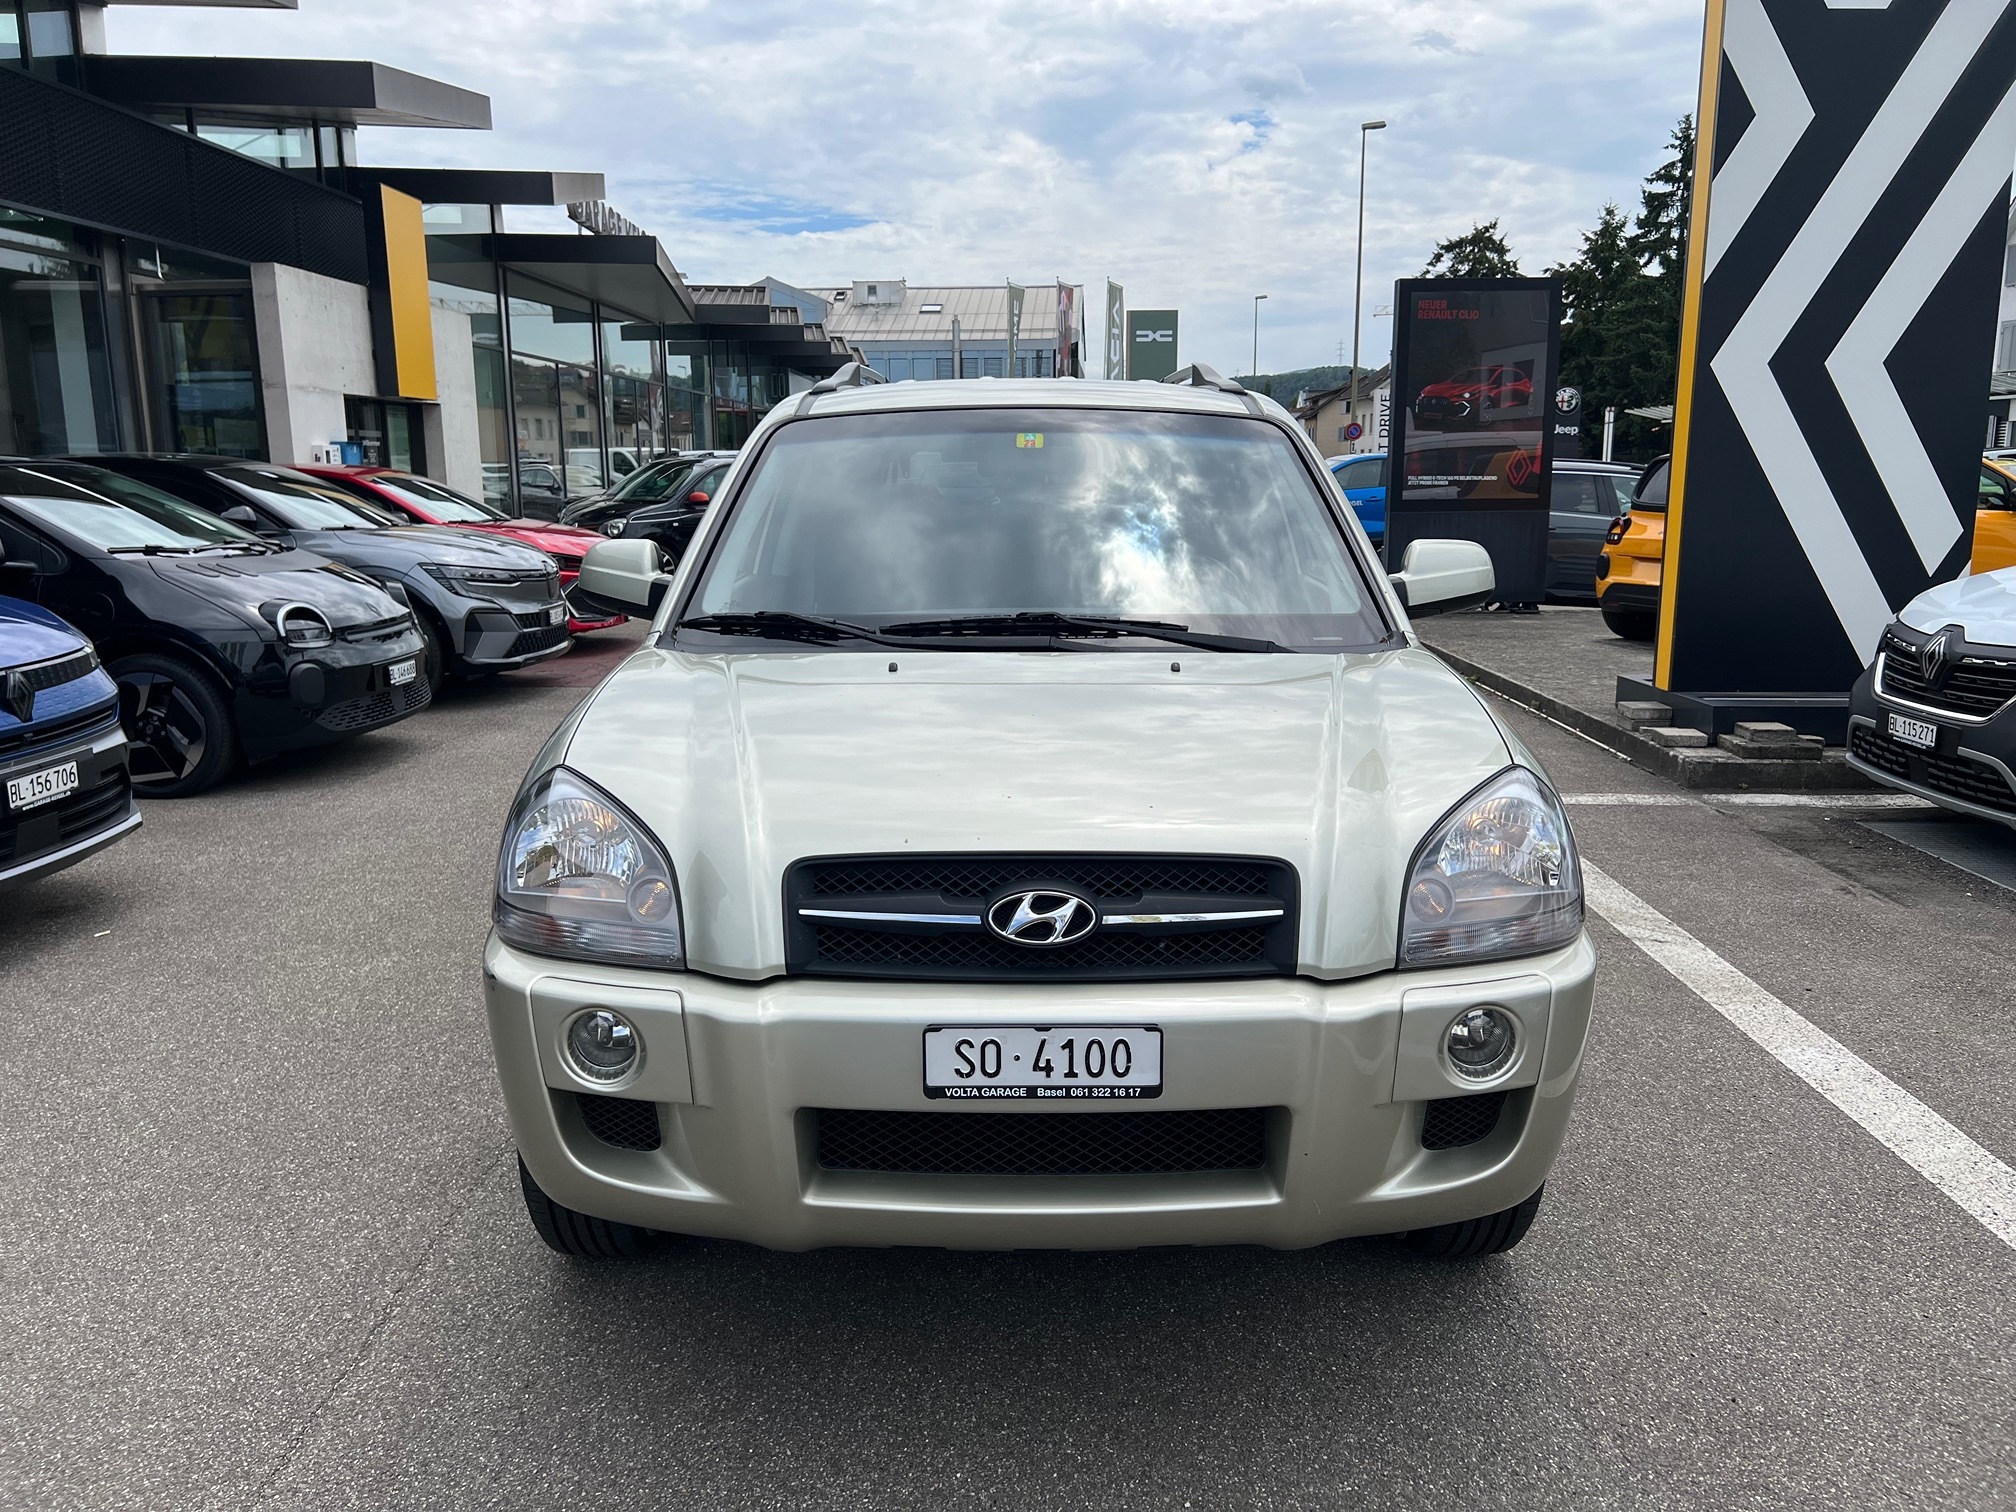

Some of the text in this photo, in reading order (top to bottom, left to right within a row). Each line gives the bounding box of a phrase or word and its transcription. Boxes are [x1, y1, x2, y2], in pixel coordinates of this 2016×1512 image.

[1418, 299, 1448, 309] NEUER
[1417, 309, 1480, 320] RENAULT CLIO
[1379, 394, 1391, 438] DRIVE
[1554, 423, 1579, 436] Jeep
[945, 1087, 1141, 1097] VOLTA GARAGE Basel 061 322 16 17
